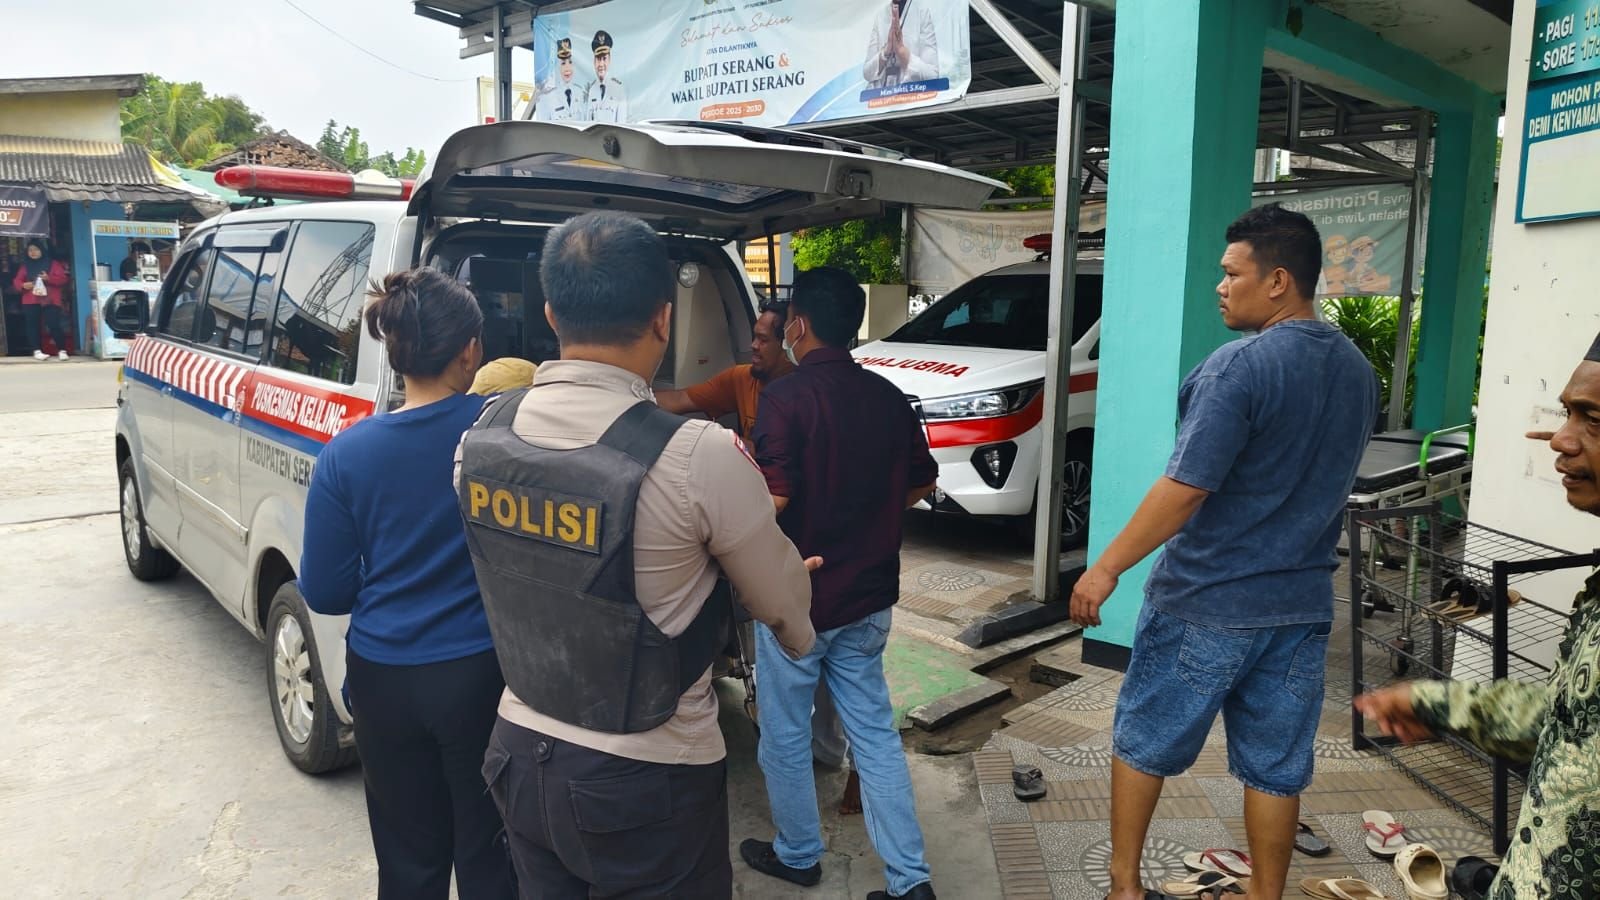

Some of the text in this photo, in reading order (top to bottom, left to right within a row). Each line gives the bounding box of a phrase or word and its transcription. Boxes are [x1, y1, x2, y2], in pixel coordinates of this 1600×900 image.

[1545, 5, 1600, 43] PAGI 11
[718, 41, 759, 53] DILANTIKNYA
[1543, 42, 1577, 71] SORE
[684, 52, 789, 84] BUPATI SERANG &
[671, 70, 805, 104] WAKIL BUPATI SERANG
[1551, 83, 1591, 110] MOHON
[726, 106, 742, 115] 2025
[746, 104, 762, 113] 2030
[1528, 115, 1551, 138] DEMI
[0, 199, 37, 208] UALITAS
[250, 382, 348, 437] PUSKESMAS KELILING
[246, 436, 317, 488] KABUPATEN SER
[468, 481, 597, 547] POLISI
